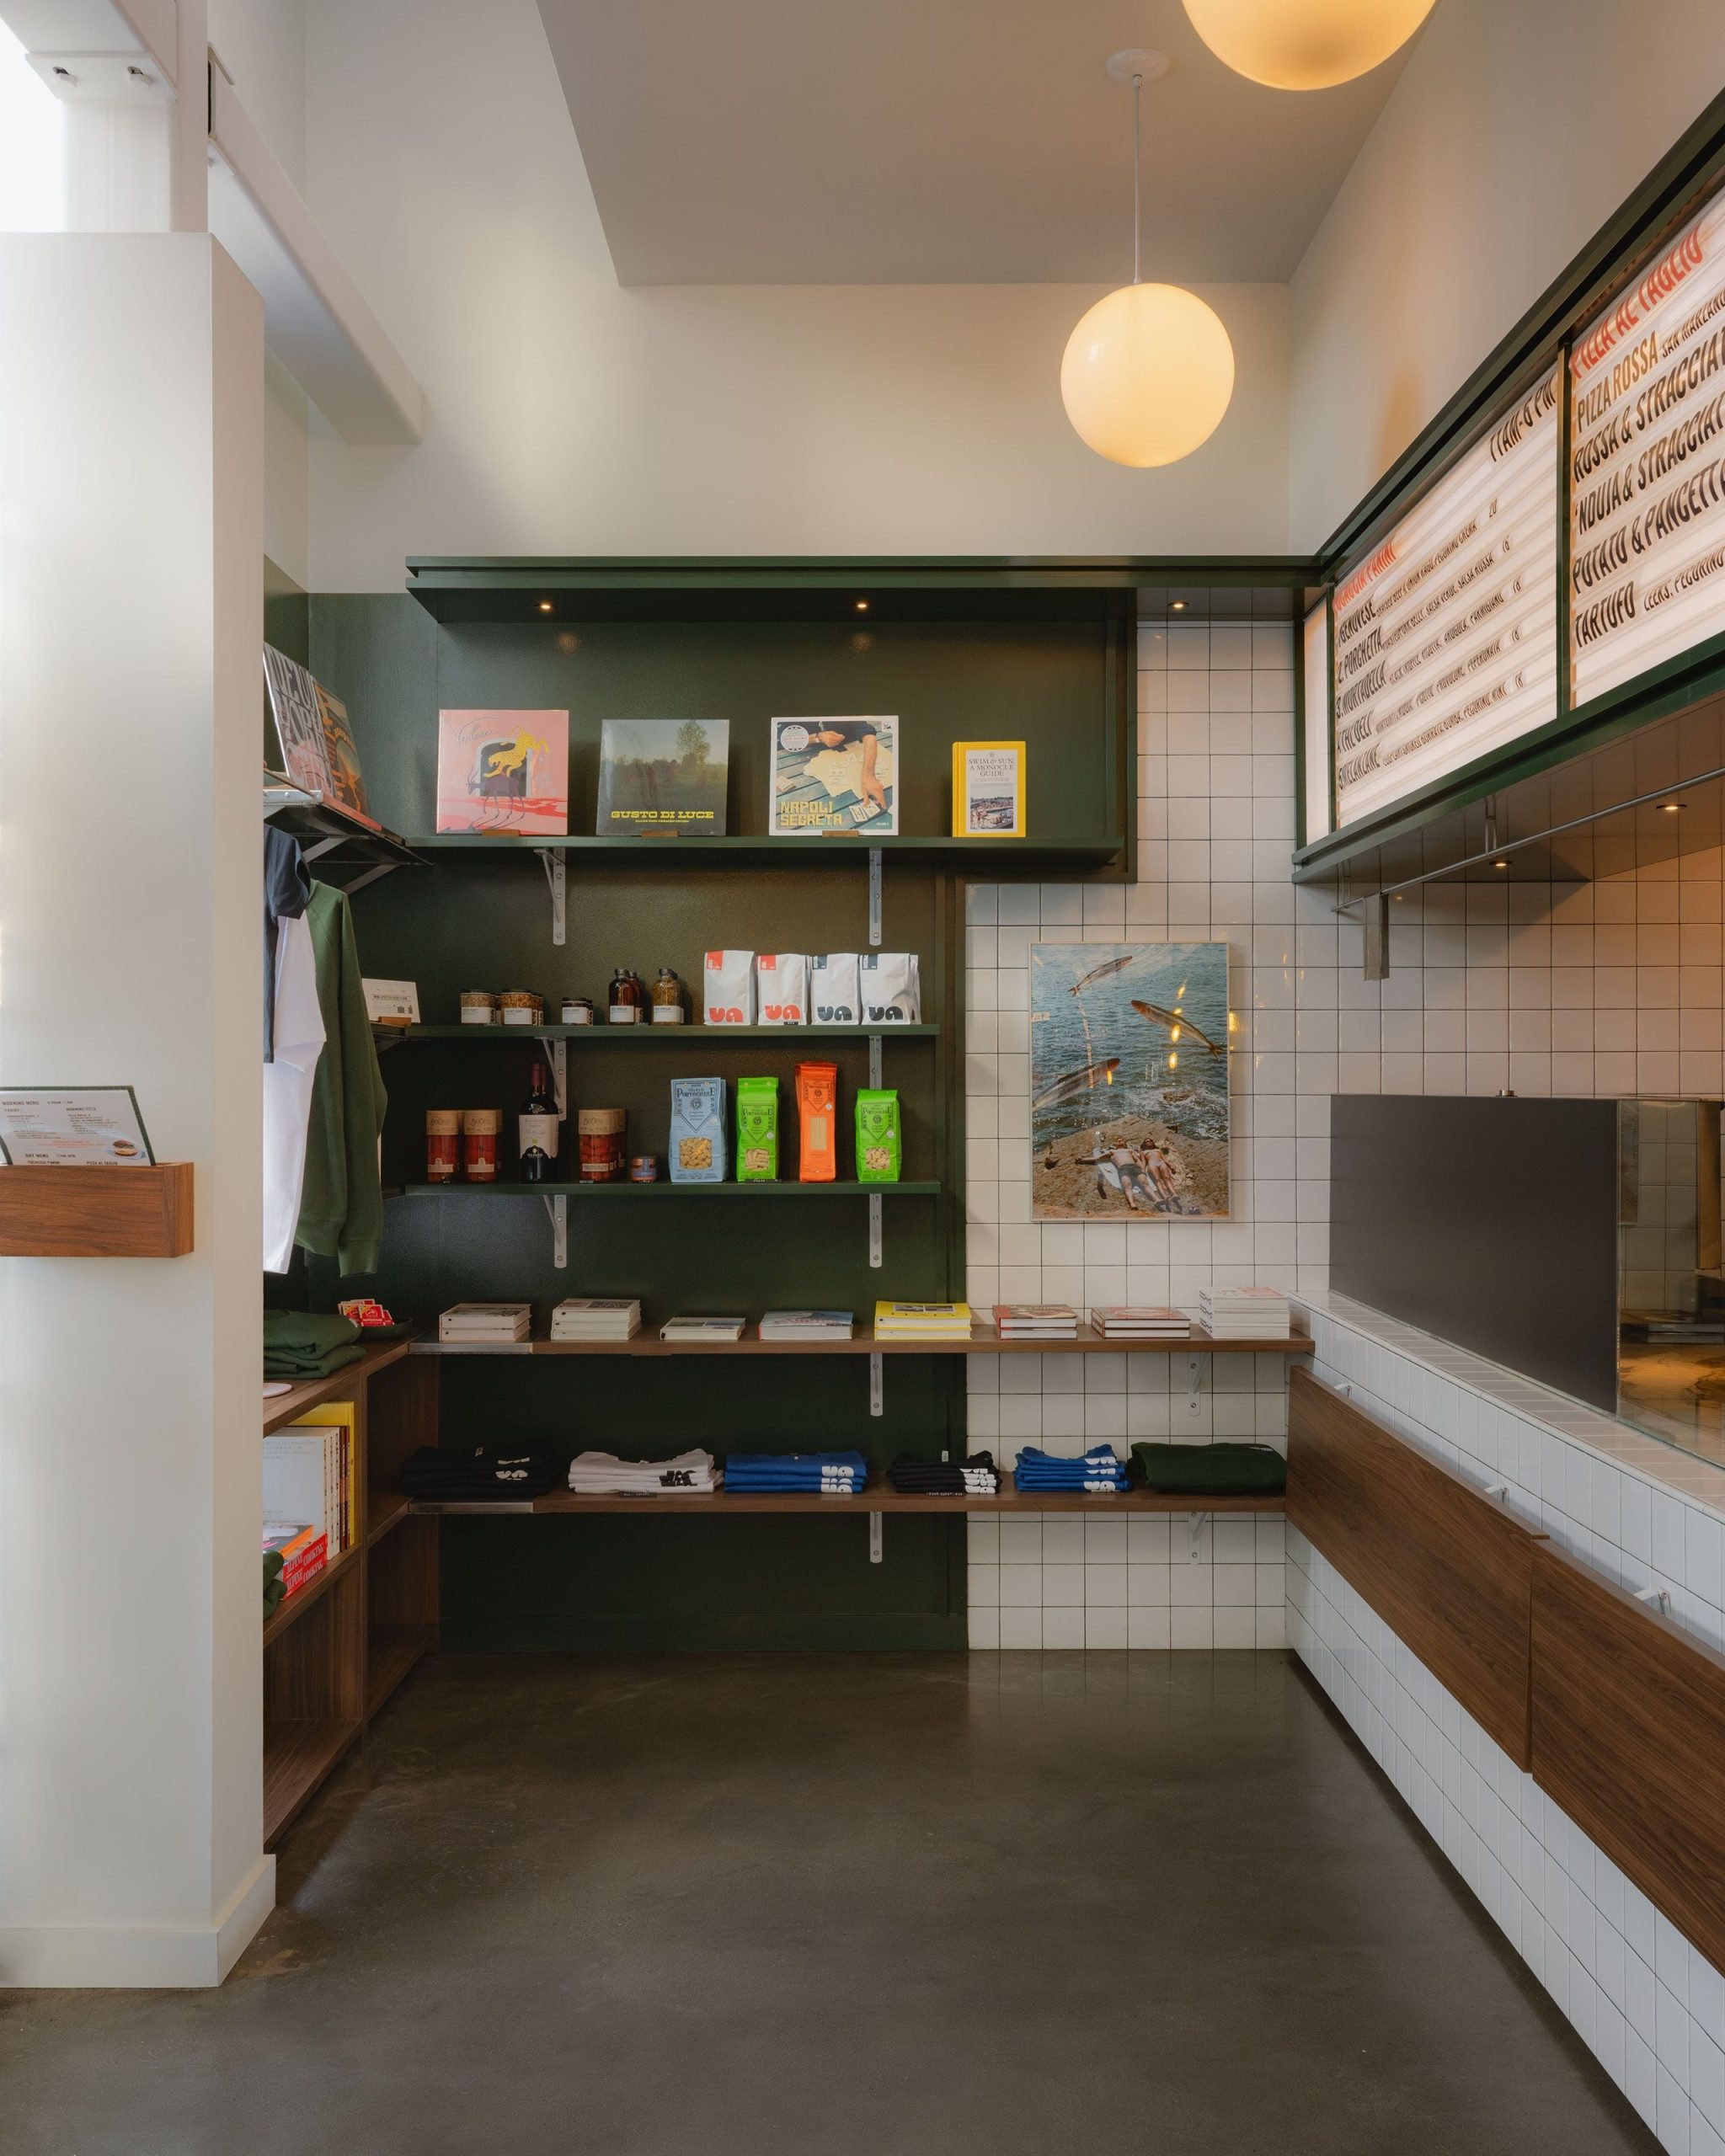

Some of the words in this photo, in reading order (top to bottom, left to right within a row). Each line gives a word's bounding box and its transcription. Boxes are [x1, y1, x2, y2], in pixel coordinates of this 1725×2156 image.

[1570, 313, 1616, 379] PIZZA
[1615, 293, 1639, 337] AL
[1534, 373, 1557, 419] PM
[1577, 374, 1611, 434] PIZZA
[1612, 330, 1659, 403] ROSSA
[1662, 335, 1682, 359] SAN
[1573, 416, 1620, 483] ROSSA
[1621, 405, 1632, 444] &
[1622, 463, 1633, 502] &
[1573, 526, 1629, 595] POTATO
[1631, 515, 1646, 554] &
[1575, 580, 1637, 648] TARTUFO
[1344, 624, 1383, 679] PORCHETTA
[611, 811, 658, 819] GUSTO
[660, 811, 676, 819] DI
[677, 811, 714, 819] LUCE
[780, 801, 833, 814] NAPOLI
[780, 814, 842, 826] SEGRETA
